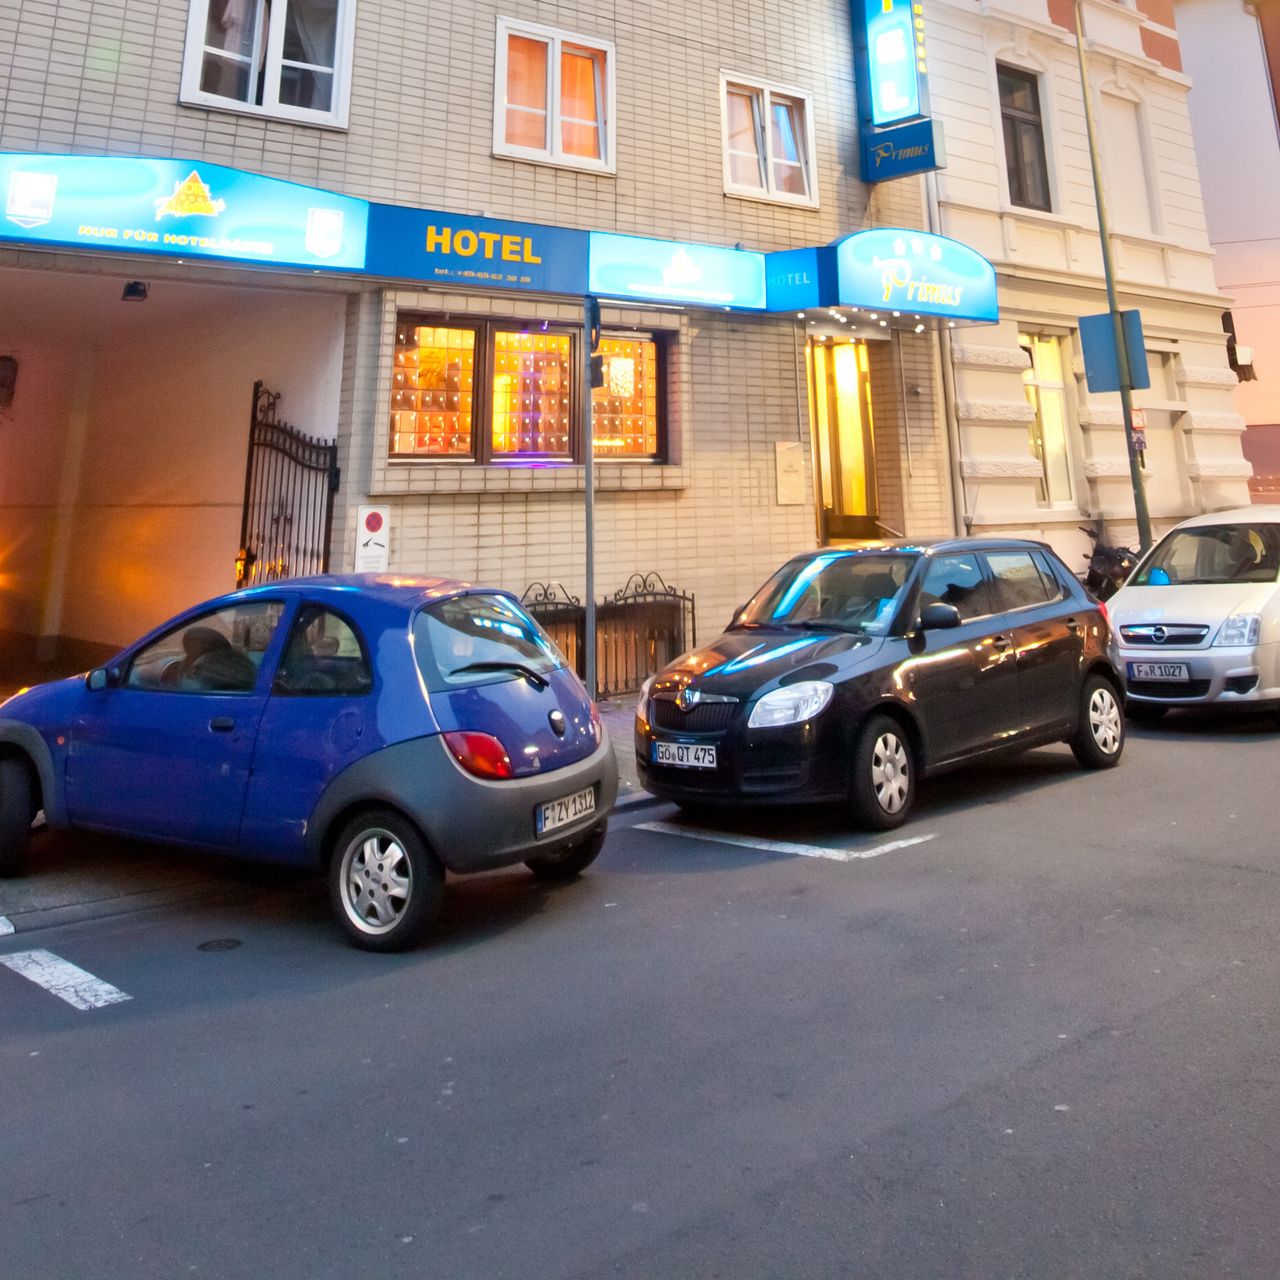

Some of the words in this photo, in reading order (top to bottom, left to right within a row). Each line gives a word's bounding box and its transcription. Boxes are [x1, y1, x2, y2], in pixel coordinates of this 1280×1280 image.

[870, 141, 930, 167] Primus
[78, 225, 118, 238] NUR
[123, 228, 159, 242] FÜR
[425, 225, 542, 265] HOTEL
[768, 272, 811, 286] HOTEL
[872, 256, 963, 306] Primus
[657, 744, 671, 760] GÖ
[677, 746, 691, 762] QT
[694, 747, 715, 764] 475
